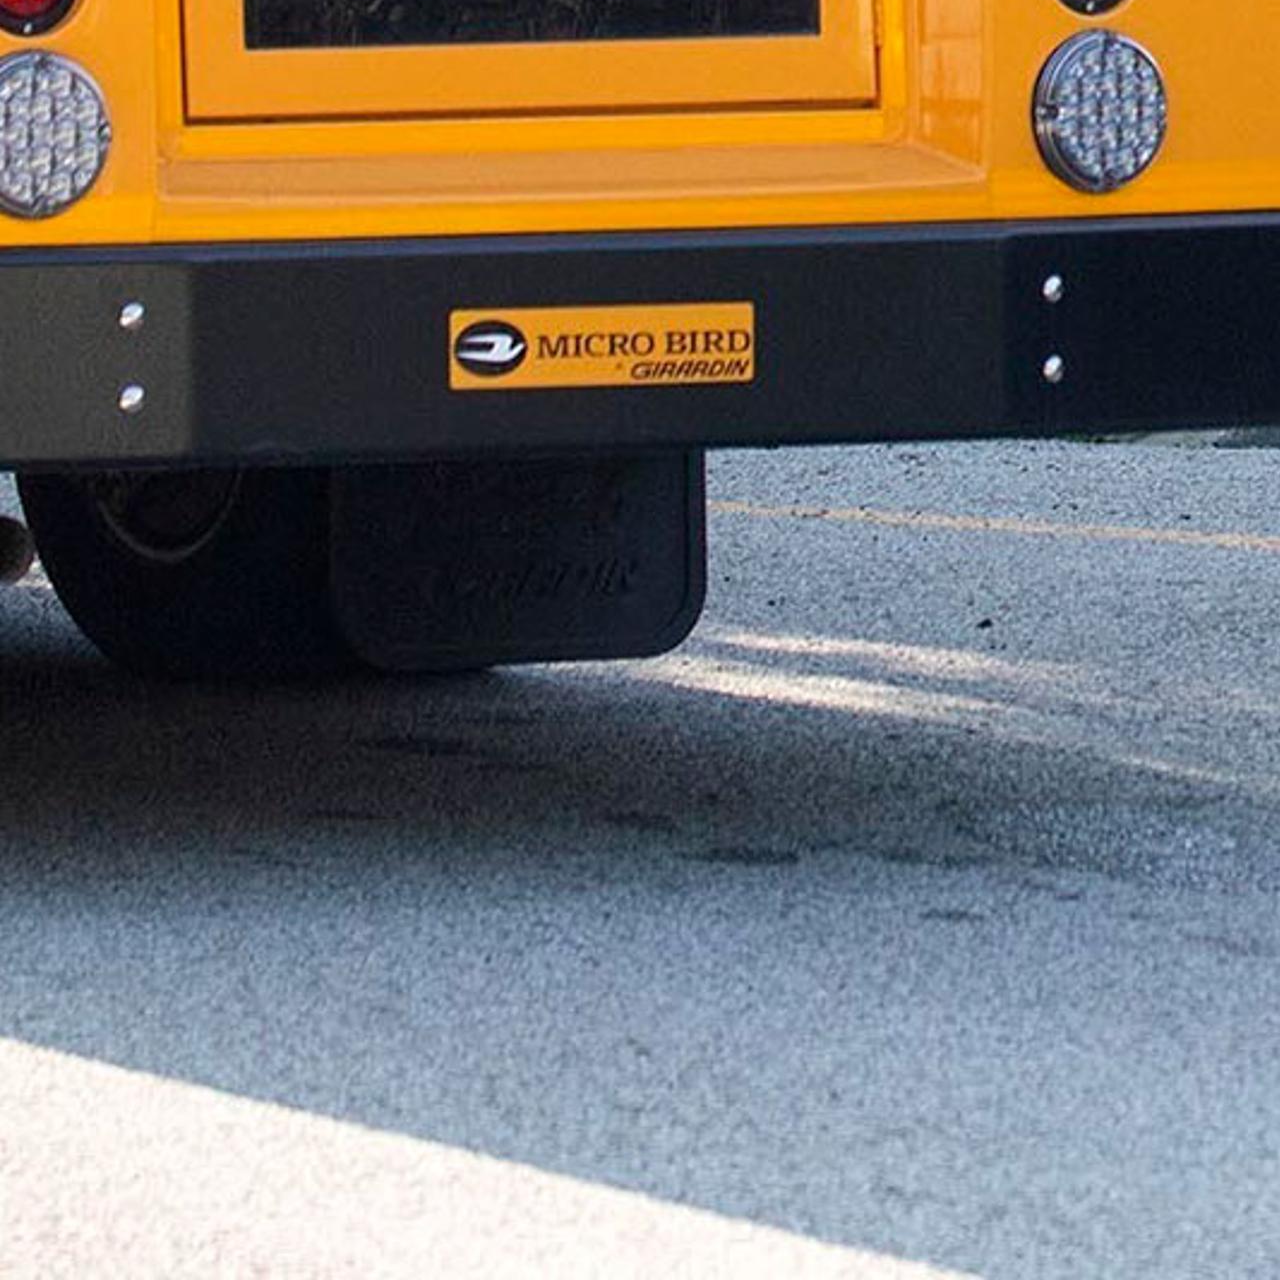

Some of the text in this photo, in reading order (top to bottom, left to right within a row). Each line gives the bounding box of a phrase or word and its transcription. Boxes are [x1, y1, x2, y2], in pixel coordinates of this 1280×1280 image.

[536, 329, 750, 359] MICRO BIRD
[630, 359, 750, 380] GIRARDIN
